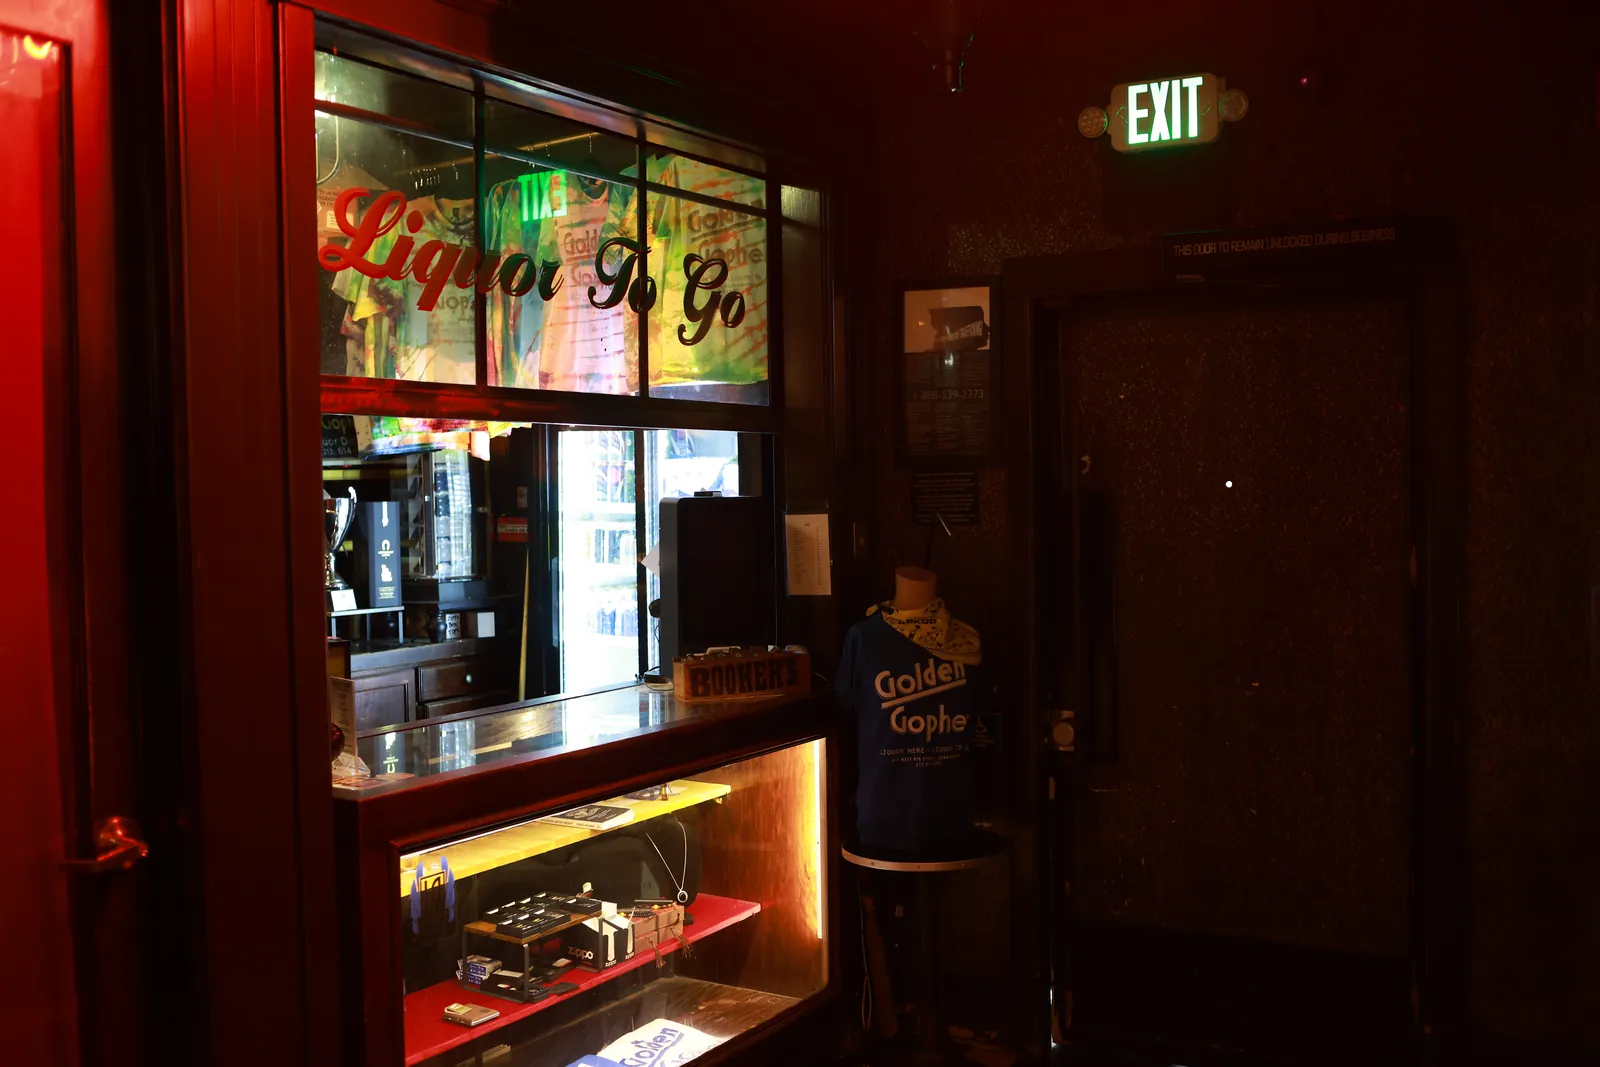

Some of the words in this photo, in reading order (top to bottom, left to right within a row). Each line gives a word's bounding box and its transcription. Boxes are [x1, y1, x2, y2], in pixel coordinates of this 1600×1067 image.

[1128, 76, 1203, 145] EXIT
[1173, 245, 1192, 259] THIS
[1193, 242, 1217, 256] DOOR
[1218, 241, 1229, 254] TO
[1231, 238, 1264, 253] REMAIN
[1265, 234, 1312, 250] UNLOCKED
[1314, 231, 1350, 246] DURING
[1351, 226, 1397, 244] BUSINESS
[318, 187, 564, 311] Liquor
[588, 237, 657, 313] To
[678, 253, 745, 345] Go
[875, 658, 967, 699] Golden
[890, 704, 969, 743] Gophe
